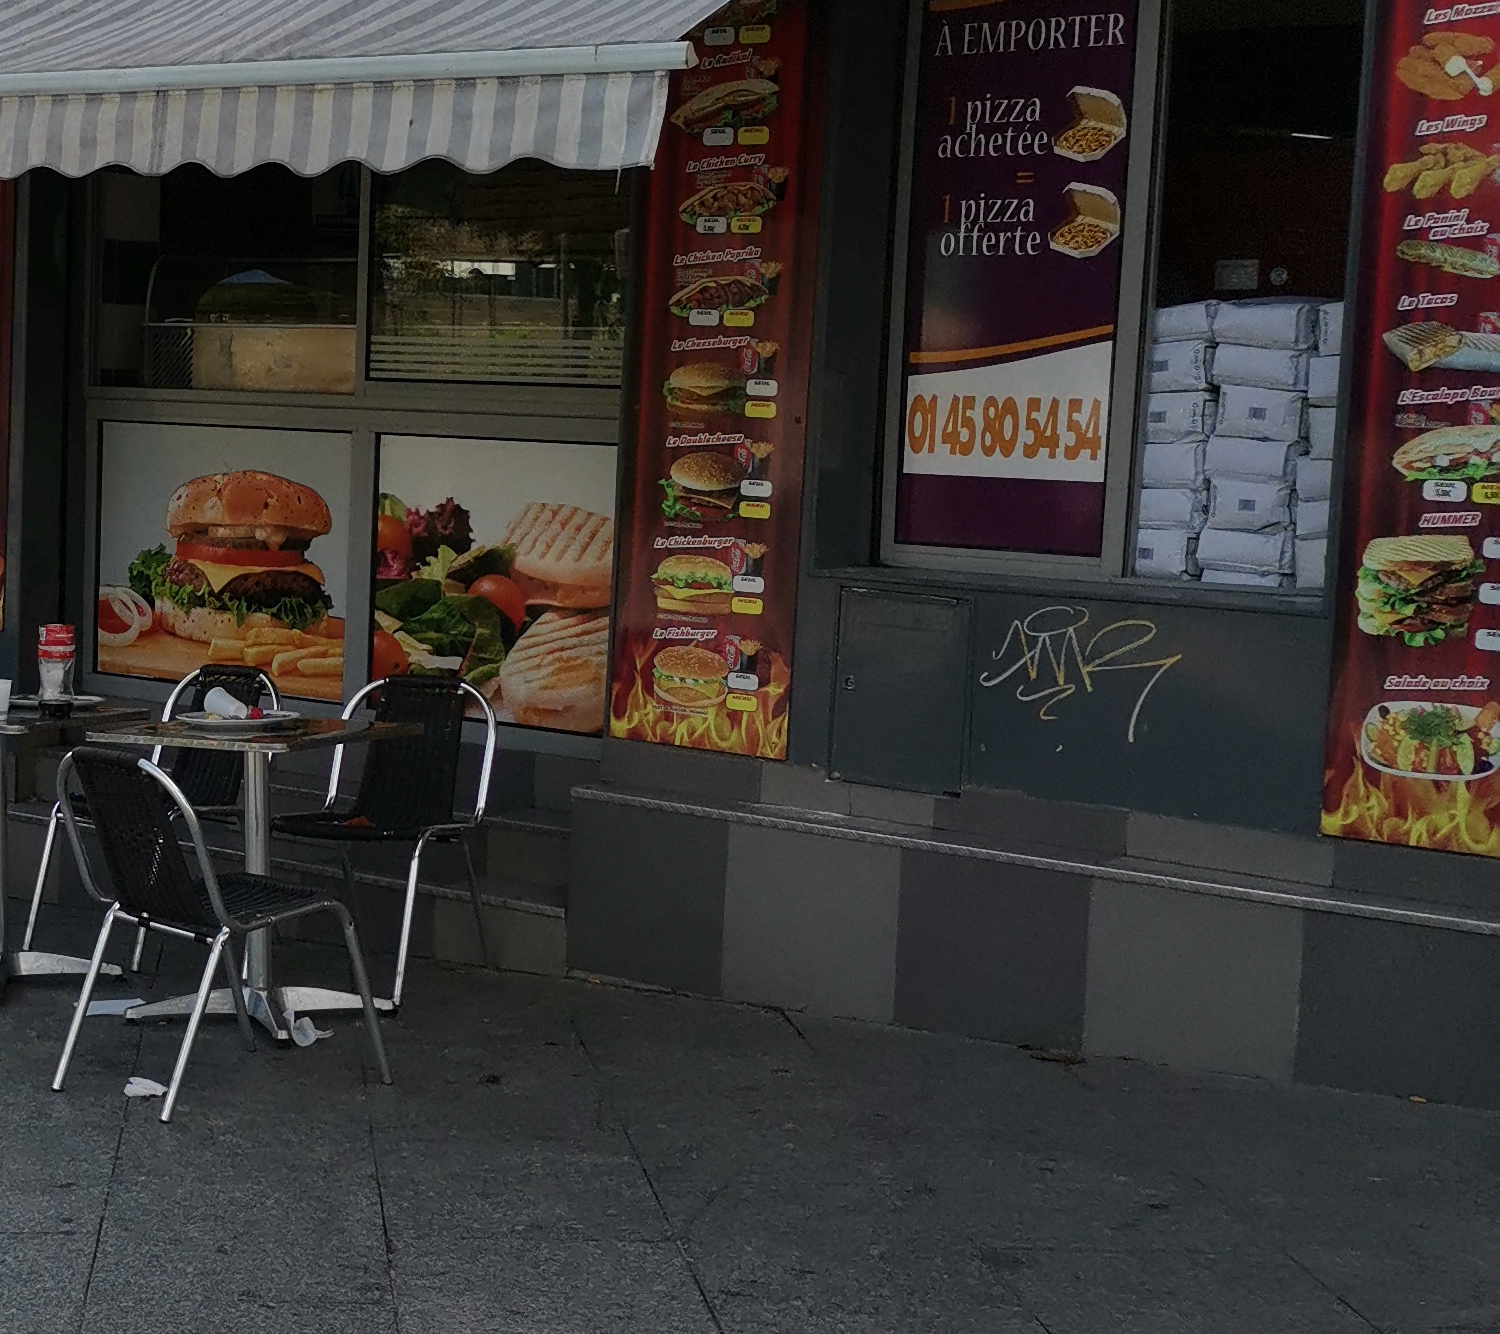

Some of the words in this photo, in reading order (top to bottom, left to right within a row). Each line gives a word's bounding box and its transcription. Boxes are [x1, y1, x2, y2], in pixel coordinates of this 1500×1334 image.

[1423, 9, 1451, 25] Les
[934, 20, 953, 57] À
[961, 13, 1126, 55] EMPORTER
[947, 96, 957, 126] 1
[965, 93, 1041, 134] pizza
[1415, 119, 1443, 135] Les
[1442, 114, 1487, 132] Wings
[937, 124, 1048, 159] achetée
[700, 156, 737, 170] Chicken
[737, 153, 765, 166] Curry
[942, 194, 951, 224] 1
[959, 193, 1035, 232] pizza
[1423, 208, 1470, 228] Panini
[940, 221, 1041, 258] offerte
[686, 249, 724, 264] Chicken
[723, 245, 761, 262] Paprika
[1417, 292, 1458, 308] Tacos
[684, 335, 750, 350] Cheeseburger
[907, 393, 937, 454] 01
[941, 393, 977, 456] 45
[980, 395, 1019, 458] 80
[1024, 396, 1060, 459] 54
[1064, 397, 1102, 461] 54
[1418, 512, 1482, 528] HUMMER
[667, 535, 735, 549] Chickenburger
[666, 627, 718, 640] Fishburger
[1384, 675, 1432, 690] Salade
[1430, 679, 1451, 690] au
